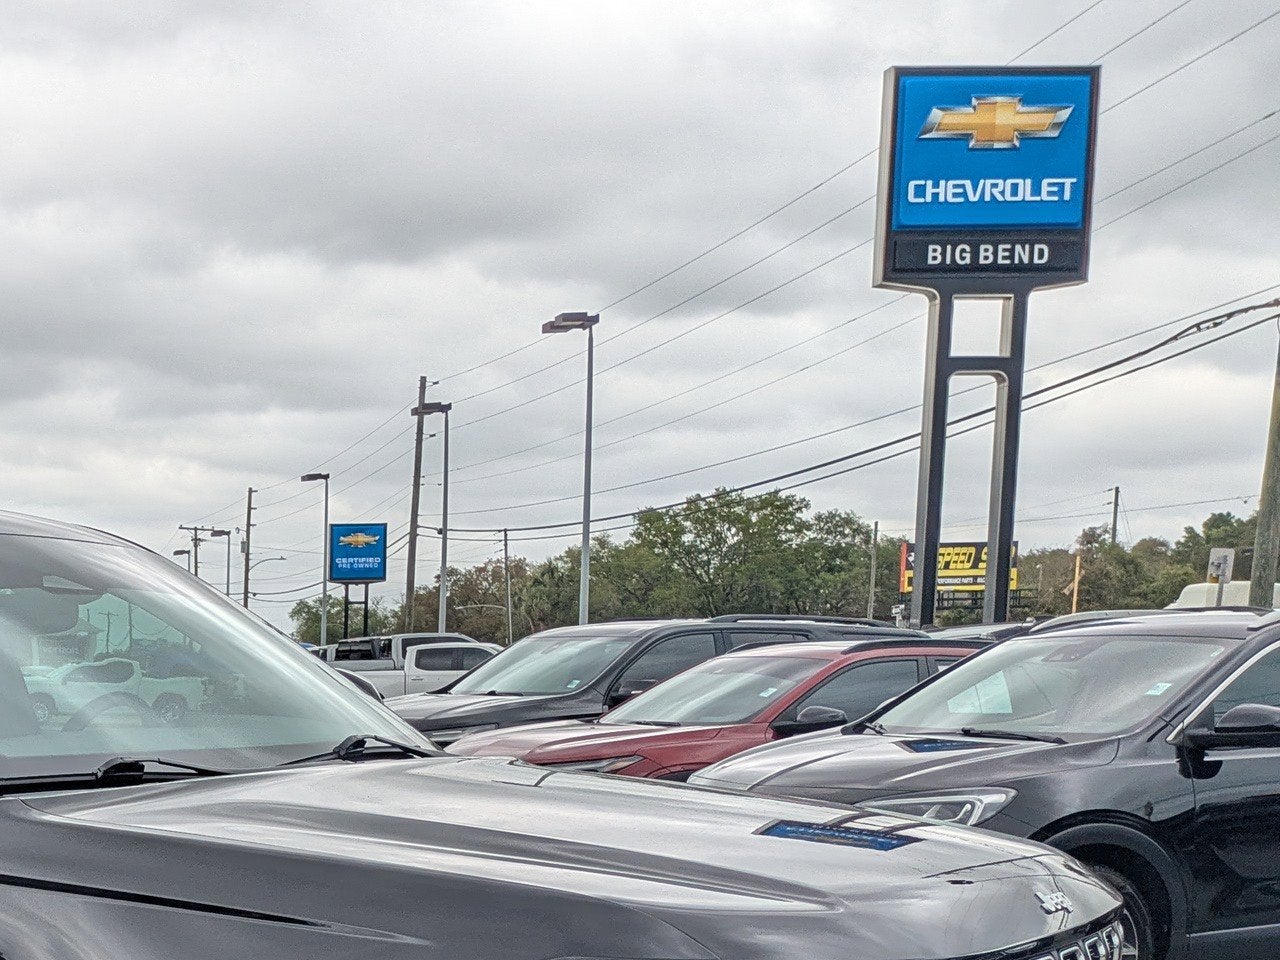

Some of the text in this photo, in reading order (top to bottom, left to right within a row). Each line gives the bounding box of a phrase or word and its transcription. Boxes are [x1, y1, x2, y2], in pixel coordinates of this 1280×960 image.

[907, 178, 1077, 202] CHEVROLET
[927, 243, 1049, 265] BIG BEND
